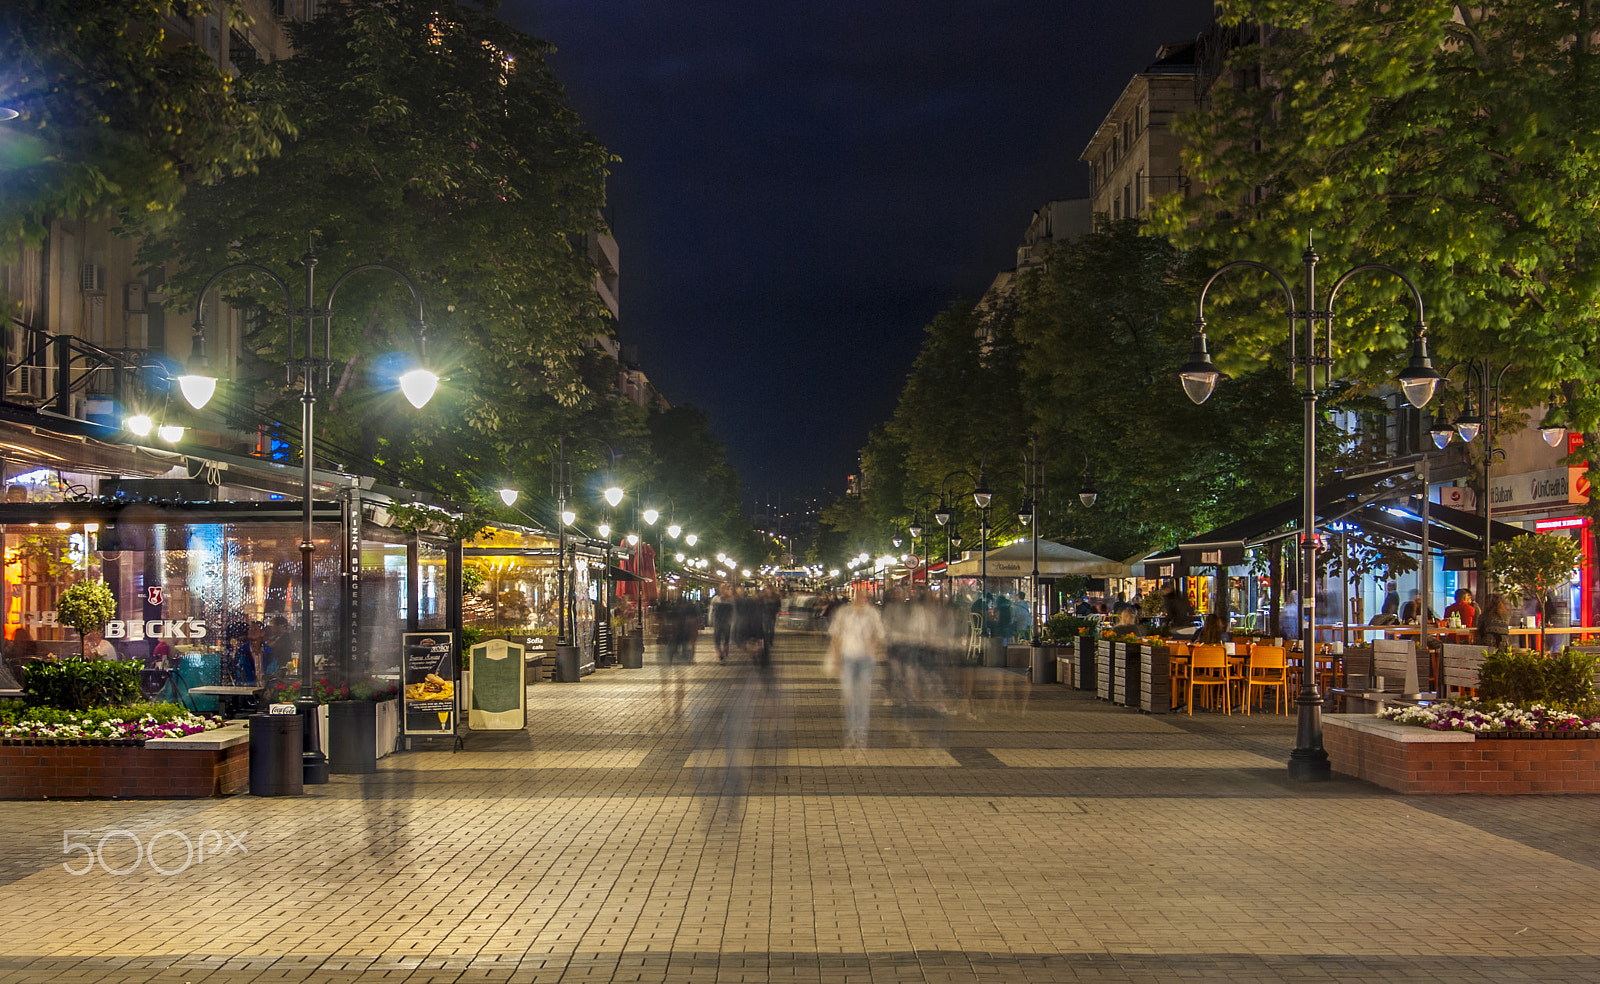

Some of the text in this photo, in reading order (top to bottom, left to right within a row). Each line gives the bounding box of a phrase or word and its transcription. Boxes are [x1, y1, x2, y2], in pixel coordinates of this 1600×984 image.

[1495, 485, 1513, 503] Bulbank
[1537, 479, 1560, 498] UniCredit
[351, 511, 359, 551] PIZZA
[351, 558, 359, 607] BURGER
[104, 616, 207, 639] BECK'S
